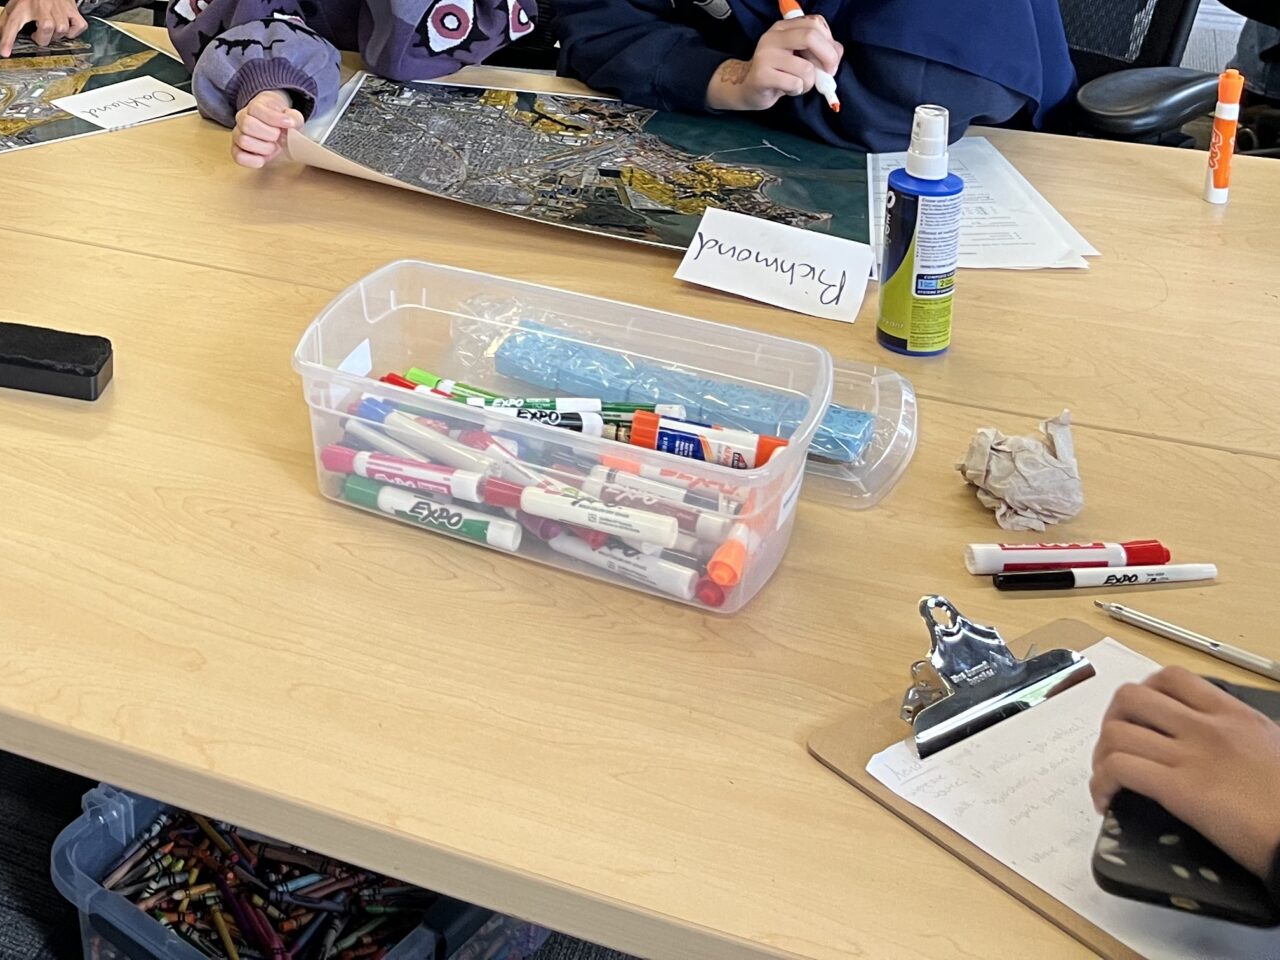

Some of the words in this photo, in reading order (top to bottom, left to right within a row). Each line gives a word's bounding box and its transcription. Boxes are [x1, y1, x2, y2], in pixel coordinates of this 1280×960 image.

[81, 90, 176, 119] Oakland
[693, 232, 847, 306] Richmond
[492, 398, 524, 408] EXPO
[516, 408, 560, 425] EXPO
[408, 500, 463, 529] EXPO
[1103, 573, 1139, 585] EXPO
